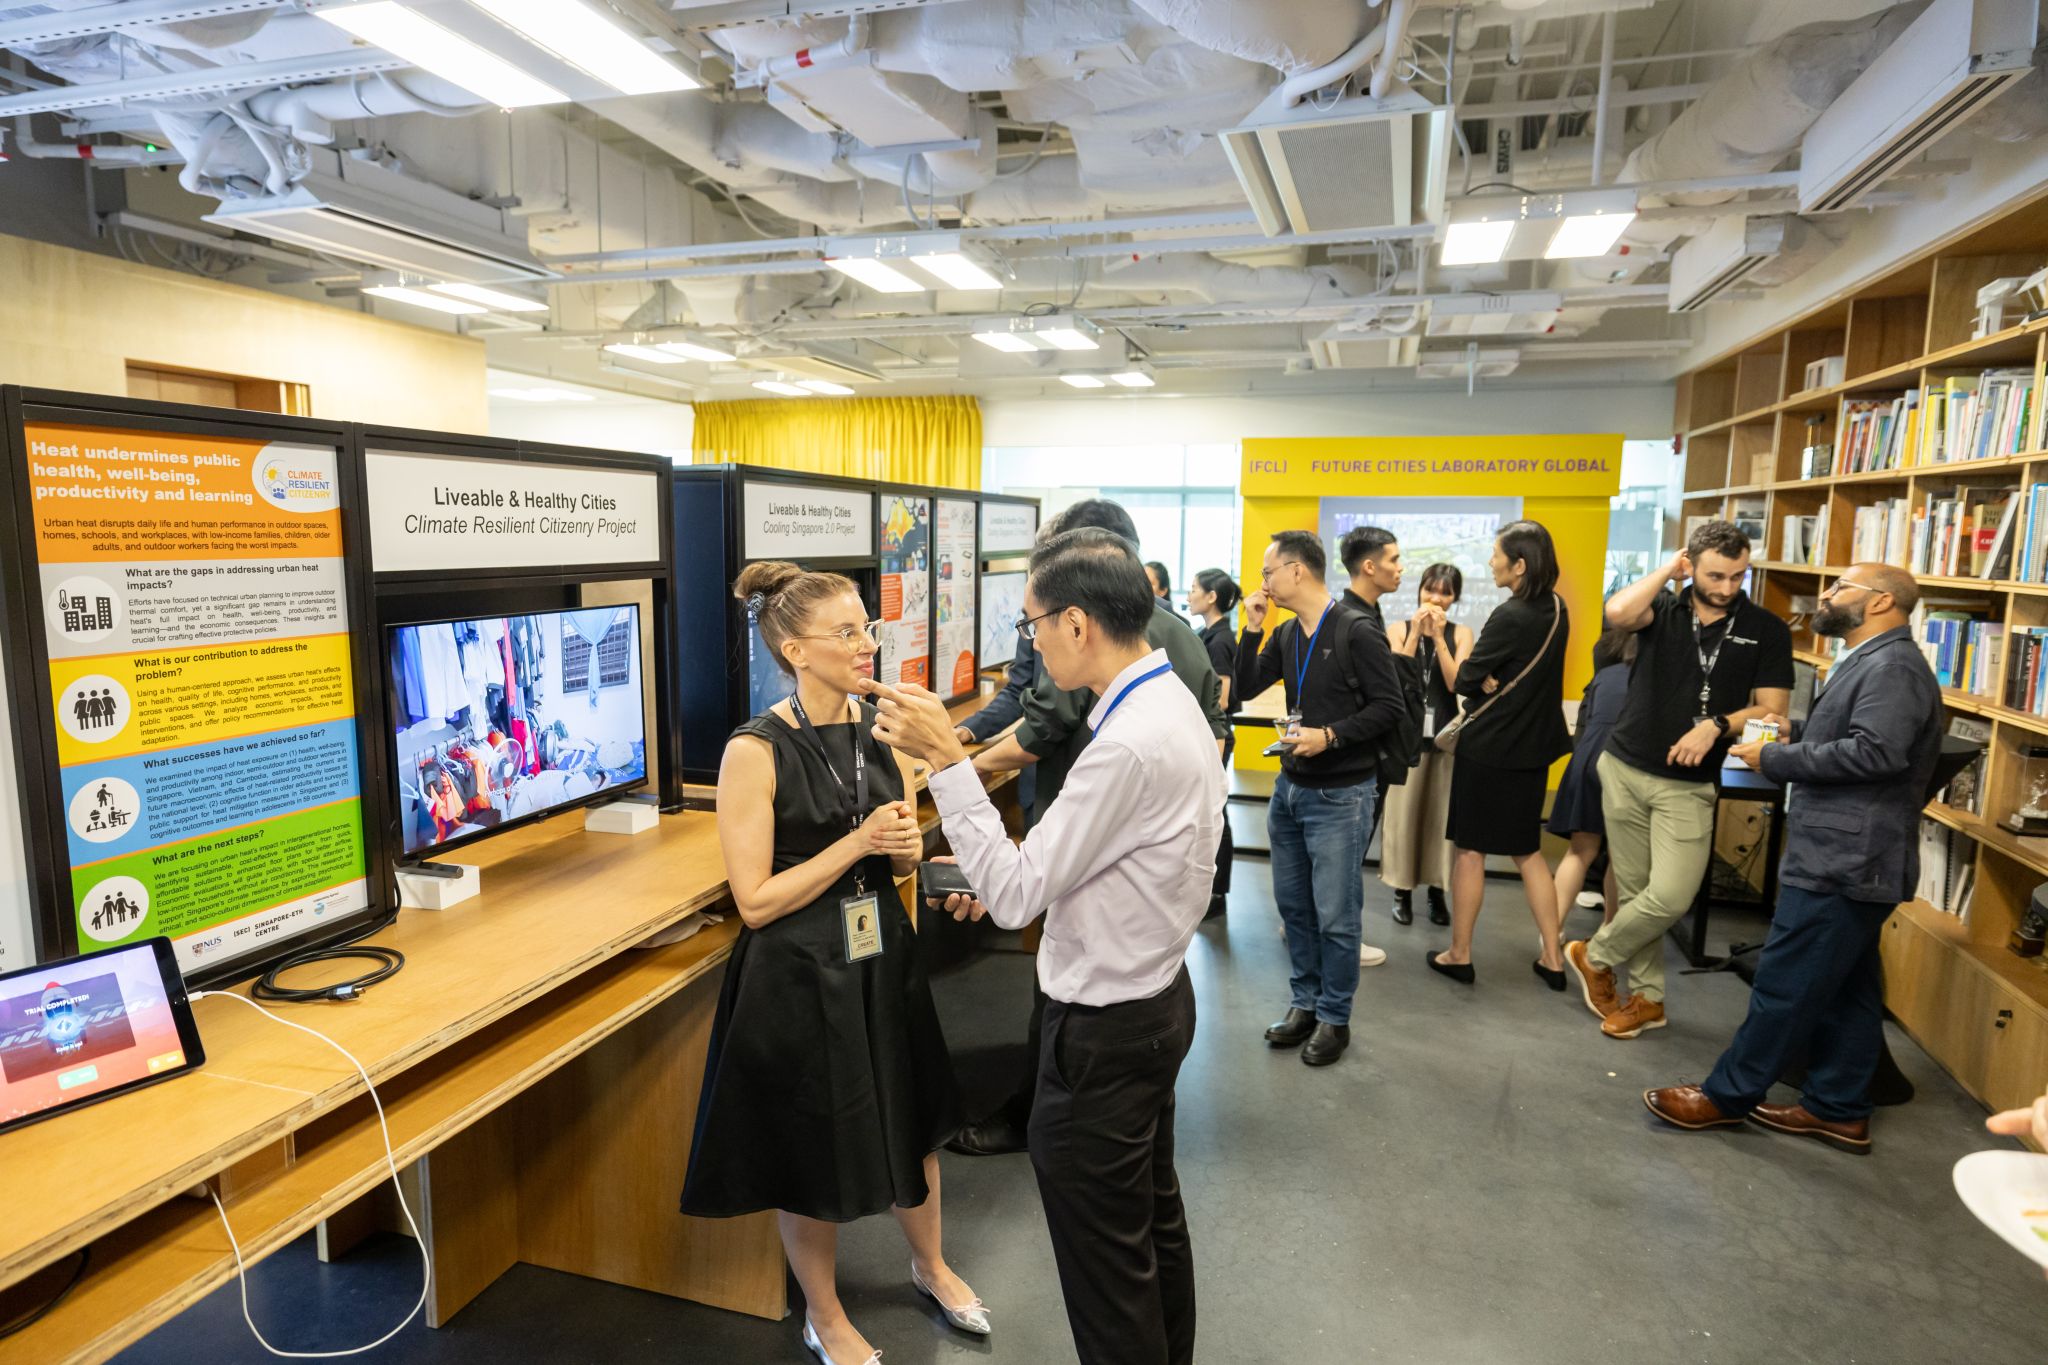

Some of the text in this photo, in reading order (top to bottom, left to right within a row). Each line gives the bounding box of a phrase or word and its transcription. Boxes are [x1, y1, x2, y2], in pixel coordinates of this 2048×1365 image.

[1498, 128, 1511, 174] CHWS
[31, 441, 240, 467] Heat undermines public
[34, 462, 200, 485] health, well-being,
[1311, 460, 1373, 473] FUTURE
[1378, 460, 1427, 473] CITIES
[1432, 459, 1539, 473] LABORATORY
[1543, 459, 1610, 472] GLOBAL
[36, 484, 253, 505] productivity and learning
[434, 487, 616, 512] Liveable & Healthy Cities
[769, 503, 851, 519] Liveable & Healthy Cities
[44, 519, 73, 527] Urban
[100, 520, 134, 529] disrupts
[138, 520, 156, 529] daily
[220, 521, 265, 530] performance
[404, 514, 636, 537] Climate Resilient Citizenry Project
[764, 521, 855, 536] Cooling Singapore 2.0 Project
[43, 531, 78, 540] homes,
[82, 531, 119, 539] schools,
[141, 532, 189, 540] workplaces,
[93, 543, 122, 551] adults,
[212, 542, 234, 550] facing
[125, 569, 152, 577] What
[191, 568, 213, 577] gaps
[227, 565, 274, 574] addressing
[127, 580, 172, 591] impacts?
[214, 603, 245, 612] significant
[134, 658, 161, 668] What
[193, 650, 247, 662] contribution
[261, 645, 292, 655] address
[136, 668, 182, 682] problem?
[137, 689, 157, 697] Using
[167, 682, 220, 692] human-centered
[1956, 721, 1983, 739] The
[144, 758, 169, 768] What
[172, 750, 220, 764] successes
[223, 746, 244, 754] have
[261, 734, 297, 747] achieved
[310, 729, 325, 738] far?
[159, 770, 192, 782] examined
[206, 763, 227, 773] impact
[152, 853, 178, 865] What
[181, 850, 195, 858] are
[215, 839, 233, 849] next
[236, 830, 264, 844] steps?
[255, 909, 303, 929] SINGAPORE-ETH
[256, 925, 279, 937] CENTRE
[204, 936, 222, 948] NUS
[24, 994, 89, 1016] TRIAL COMPLETED!
